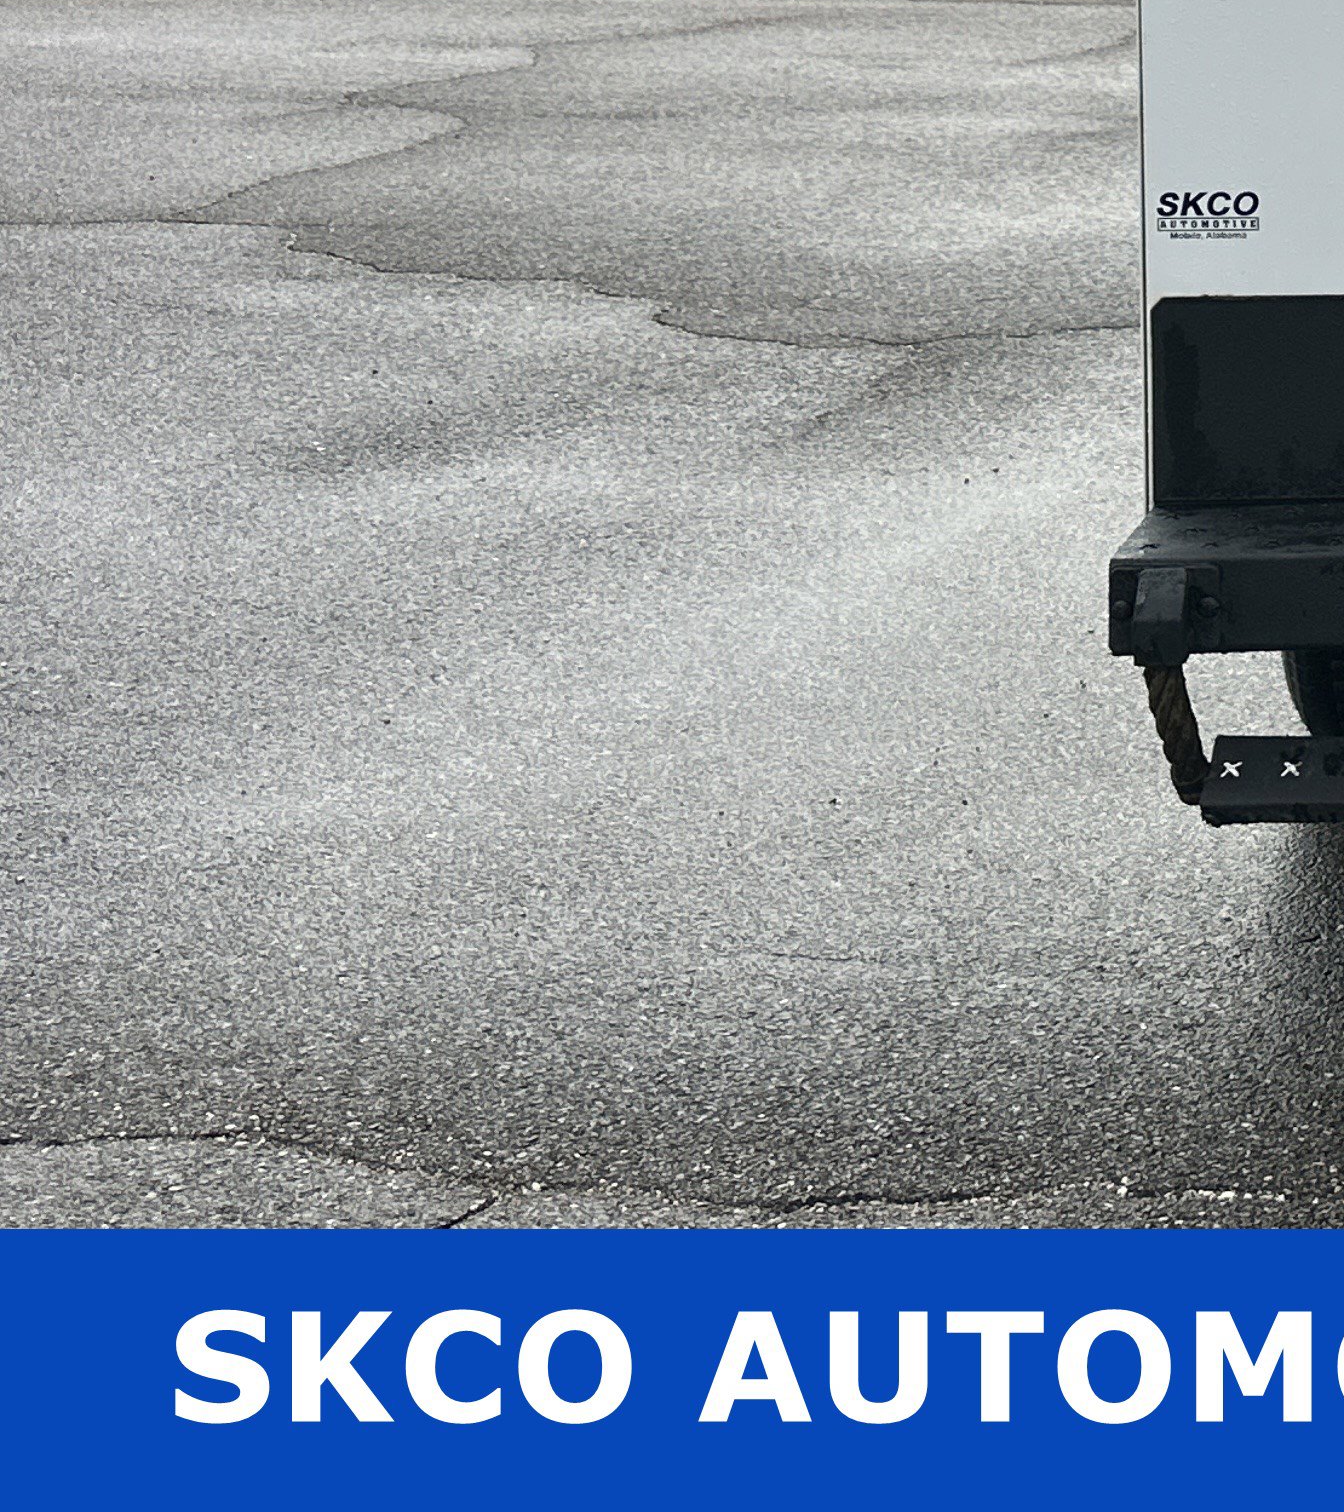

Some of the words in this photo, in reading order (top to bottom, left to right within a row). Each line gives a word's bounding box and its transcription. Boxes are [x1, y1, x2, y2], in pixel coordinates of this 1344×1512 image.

[1156, 191, 1259, 217] SKCO
[1160, 220, 1257, 229] AUTOMOTIVE
[1206, 231, 1248, 240] Alabama
